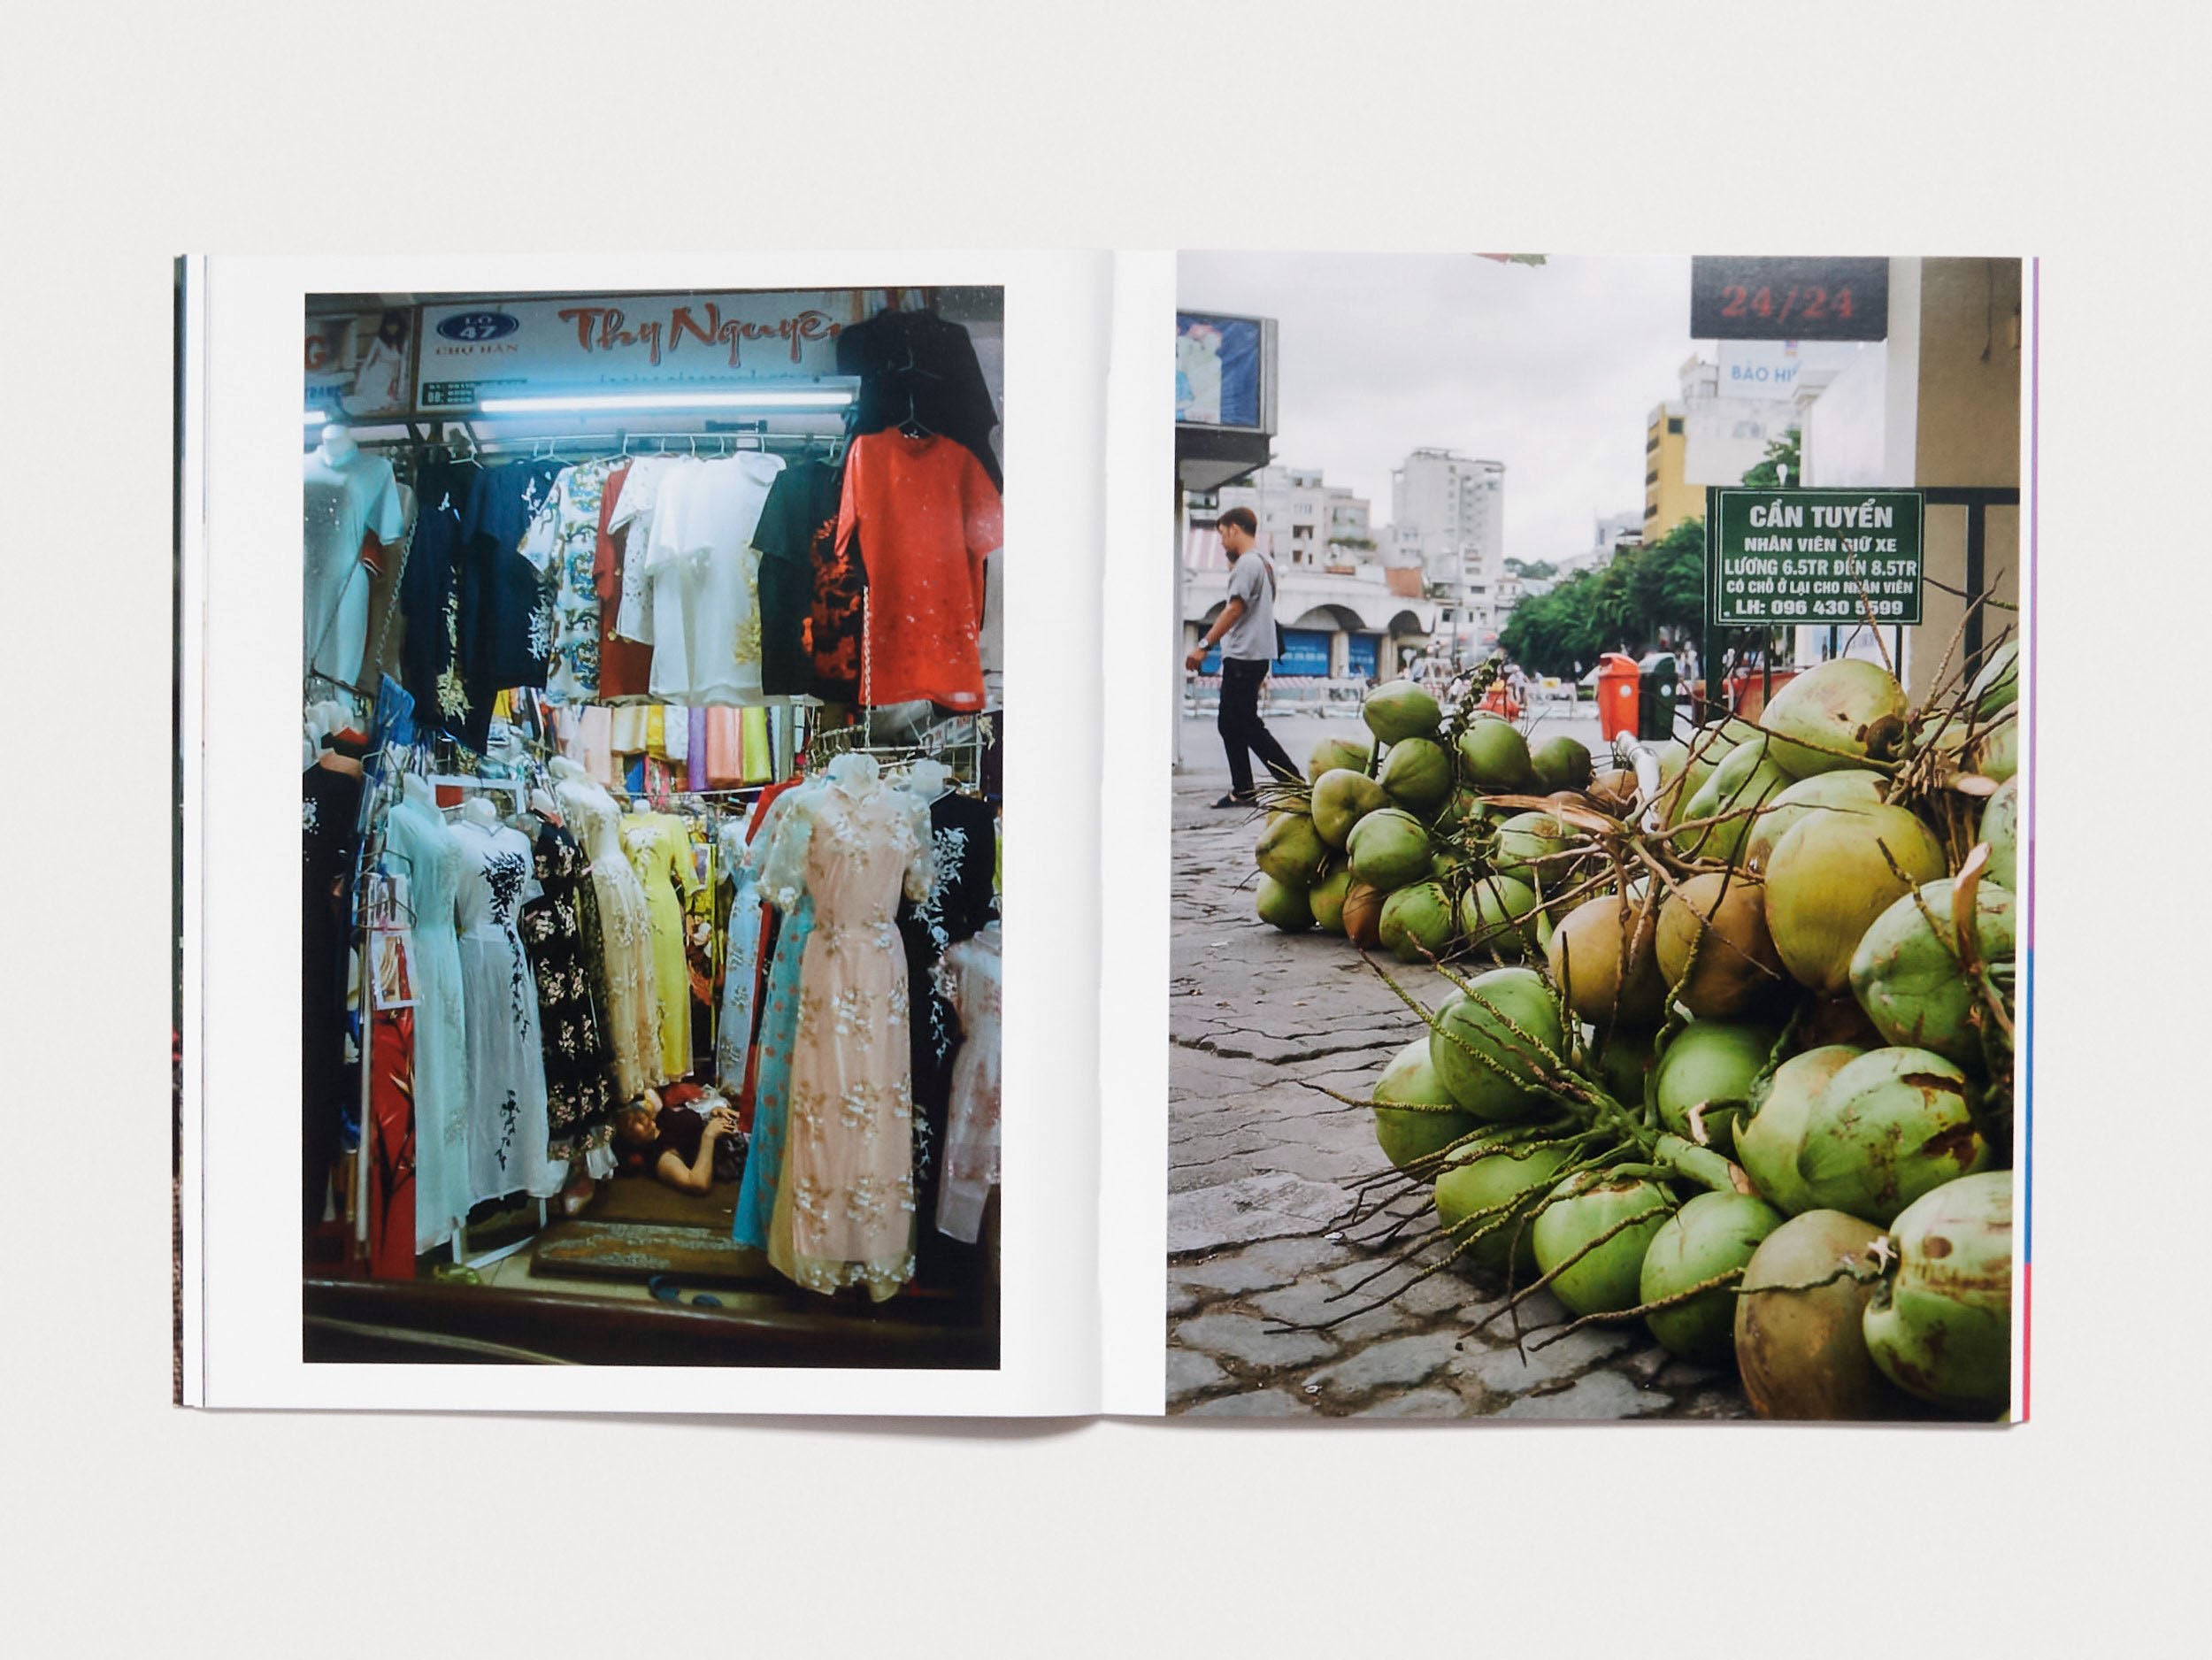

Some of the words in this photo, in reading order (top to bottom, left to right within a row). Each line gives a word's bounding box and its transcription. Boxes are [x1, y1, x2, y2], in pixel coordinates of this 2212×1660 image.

[1721, 285, 1853, 324] 24/24
[460, 325, 497, 338] 47
[1775, 361, 1801, 382] HI
[1811, 498, 1893, 528] TUYỂN
[1745, 535, 1793, 552] NHÂN
[1797, 535, 1837, 552] VIÊN
[1876, 538, 1897, 552] XE
[1725, 556, 1778, 575] LƯƠNG
[1783, 559, 1828, 575] 6.5TR
[1871, 559, 1917, 576] 8.5TR
[1790, 580, 1810, 596] LẠI
[1813, 581, 1839, 594] CHO
[1884, 579, 1913, 594] VIÊN
[1736, 599, 1766, 614] LH:
[1771, 600, 1807, 615] 096
[1813, 600, 1849, 615] 430
